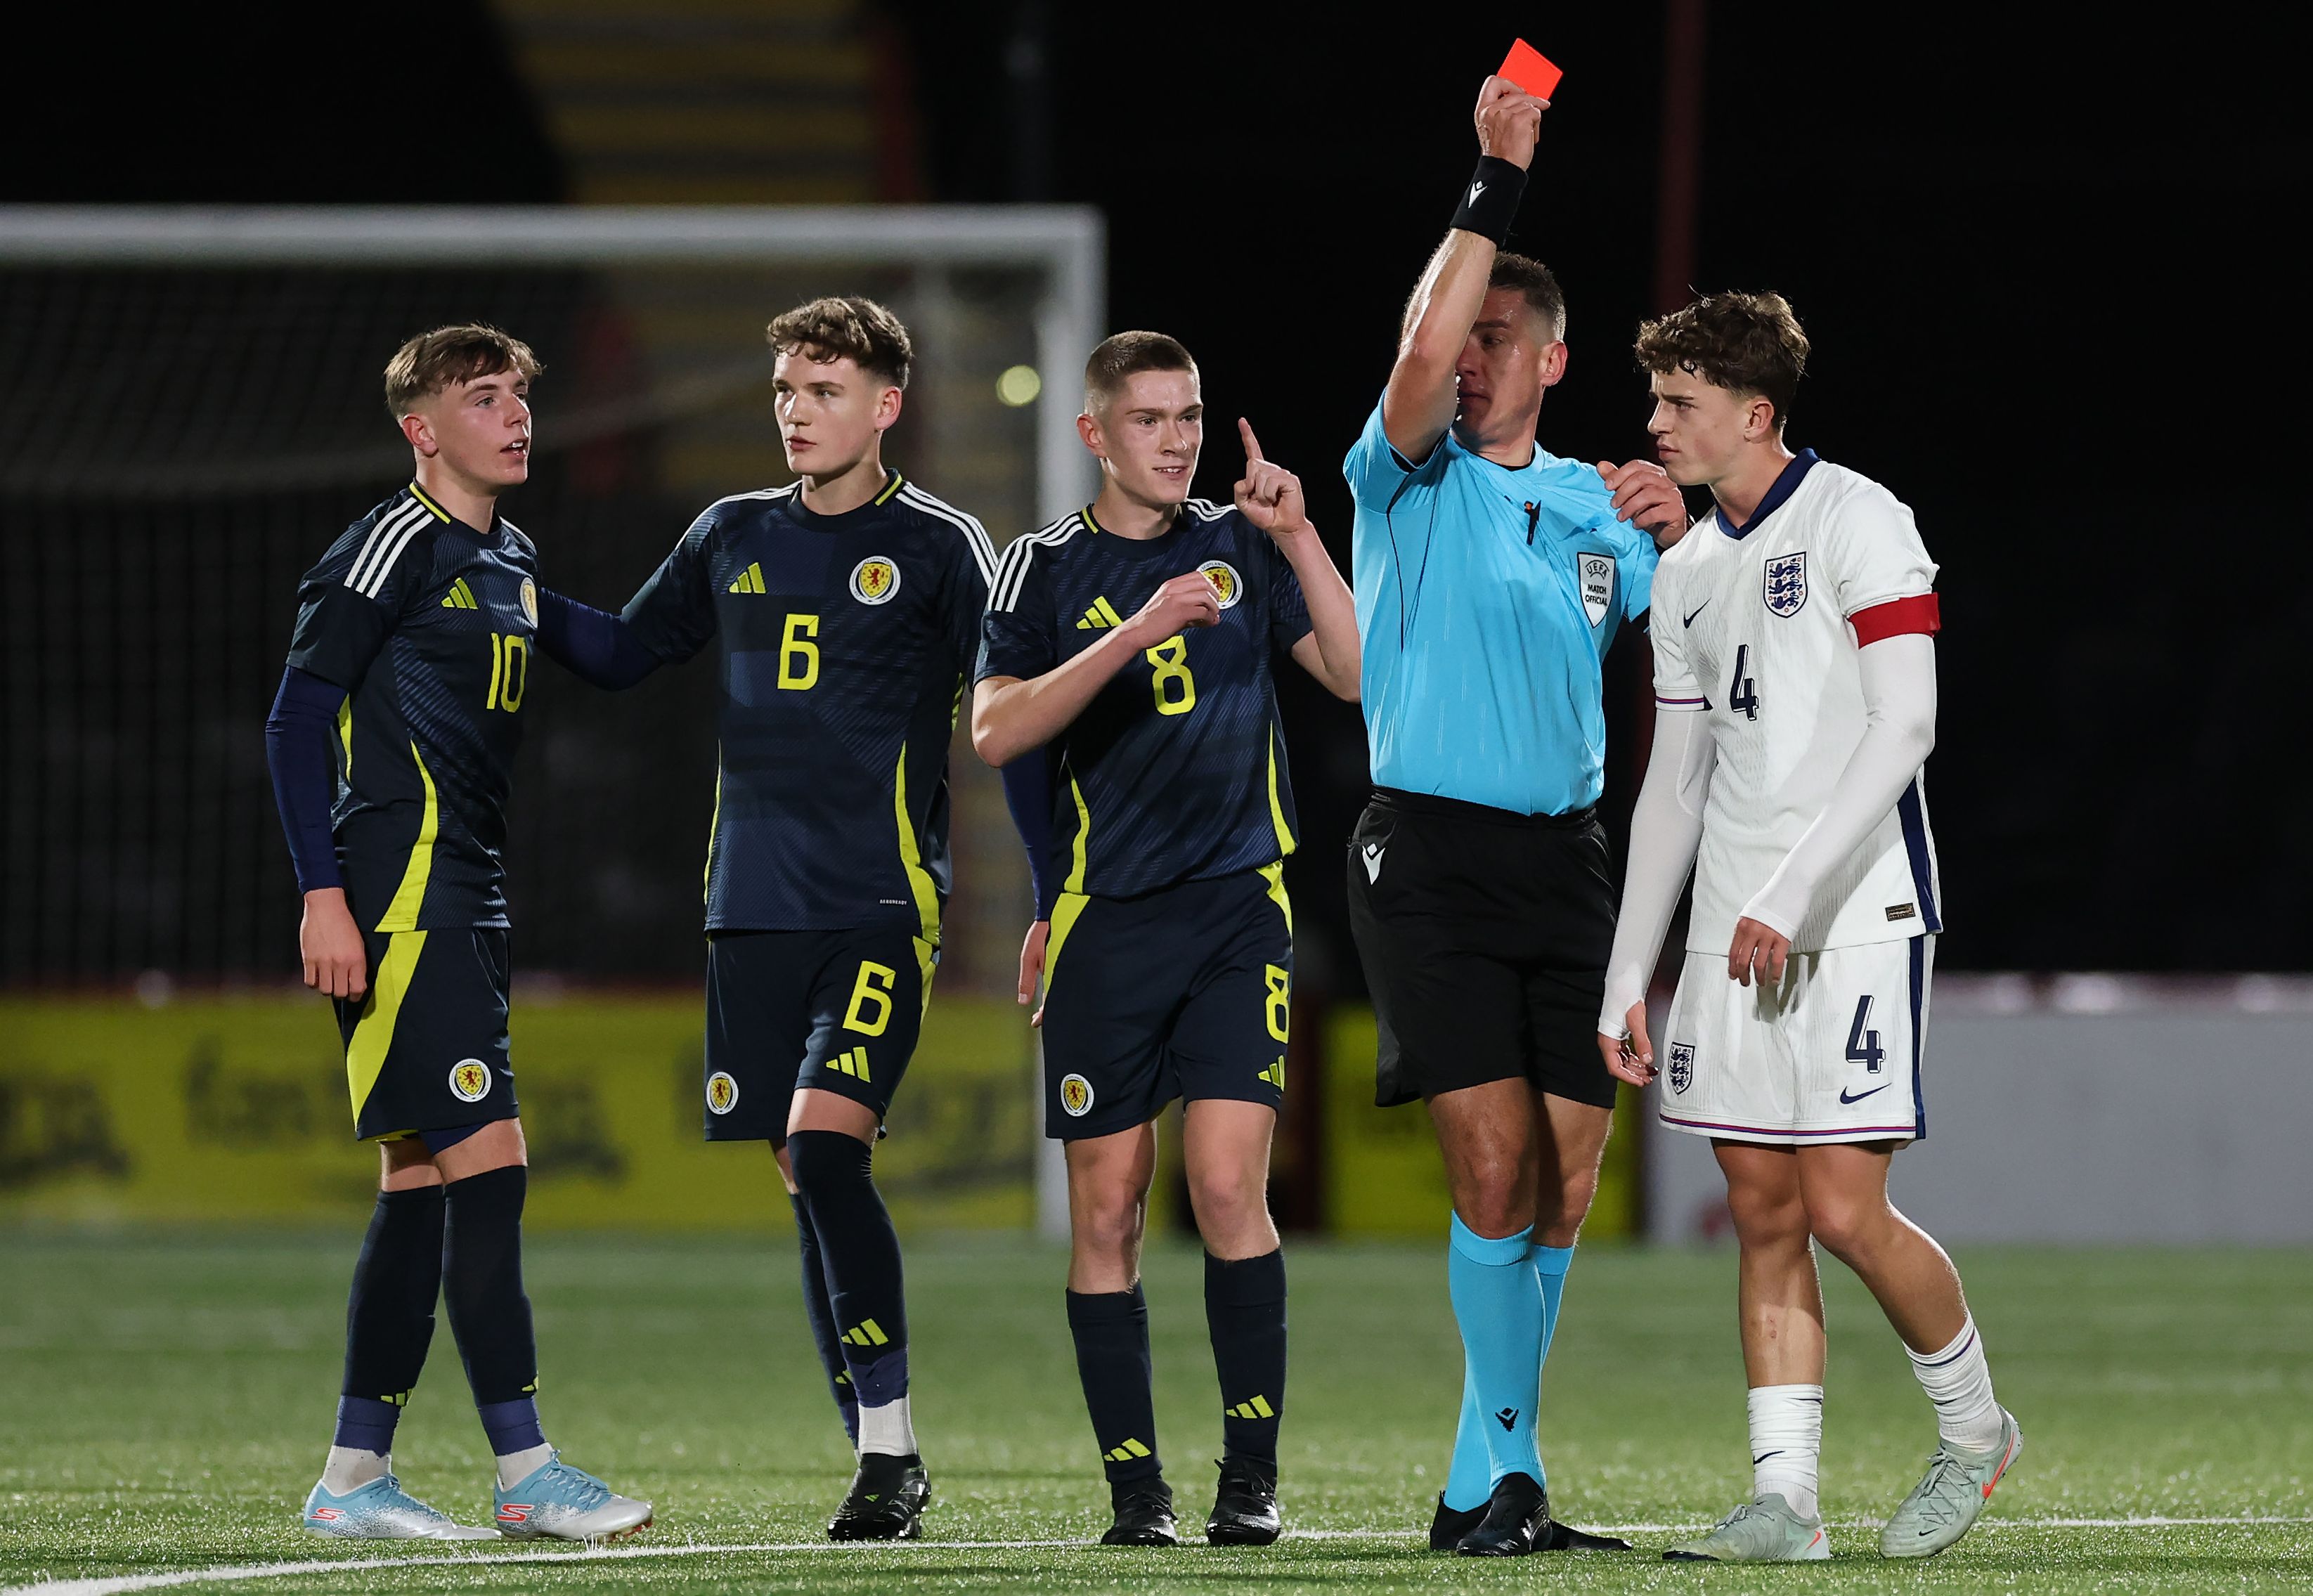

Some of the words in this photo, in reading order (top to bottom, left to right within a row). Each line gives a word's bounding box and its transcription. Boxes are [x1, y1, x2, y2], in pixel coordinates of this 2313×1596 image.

[1585, 594, 1607, 606] OFFICIAL
[1586, 562, 1607, 577] UEFA
[1588, 584, 1607, 595] MATCH
[486, 632, 527, 713] 10
[777, 614, 819, 691] 6
[1146, 636, 1196, 716] 8
[1729, 644, 1760, 722] 4
[843, 960, 896, 1037] 6
[1265, 964, 1290, 1044] 8
[1845, 994, 1886, 1074] 4
